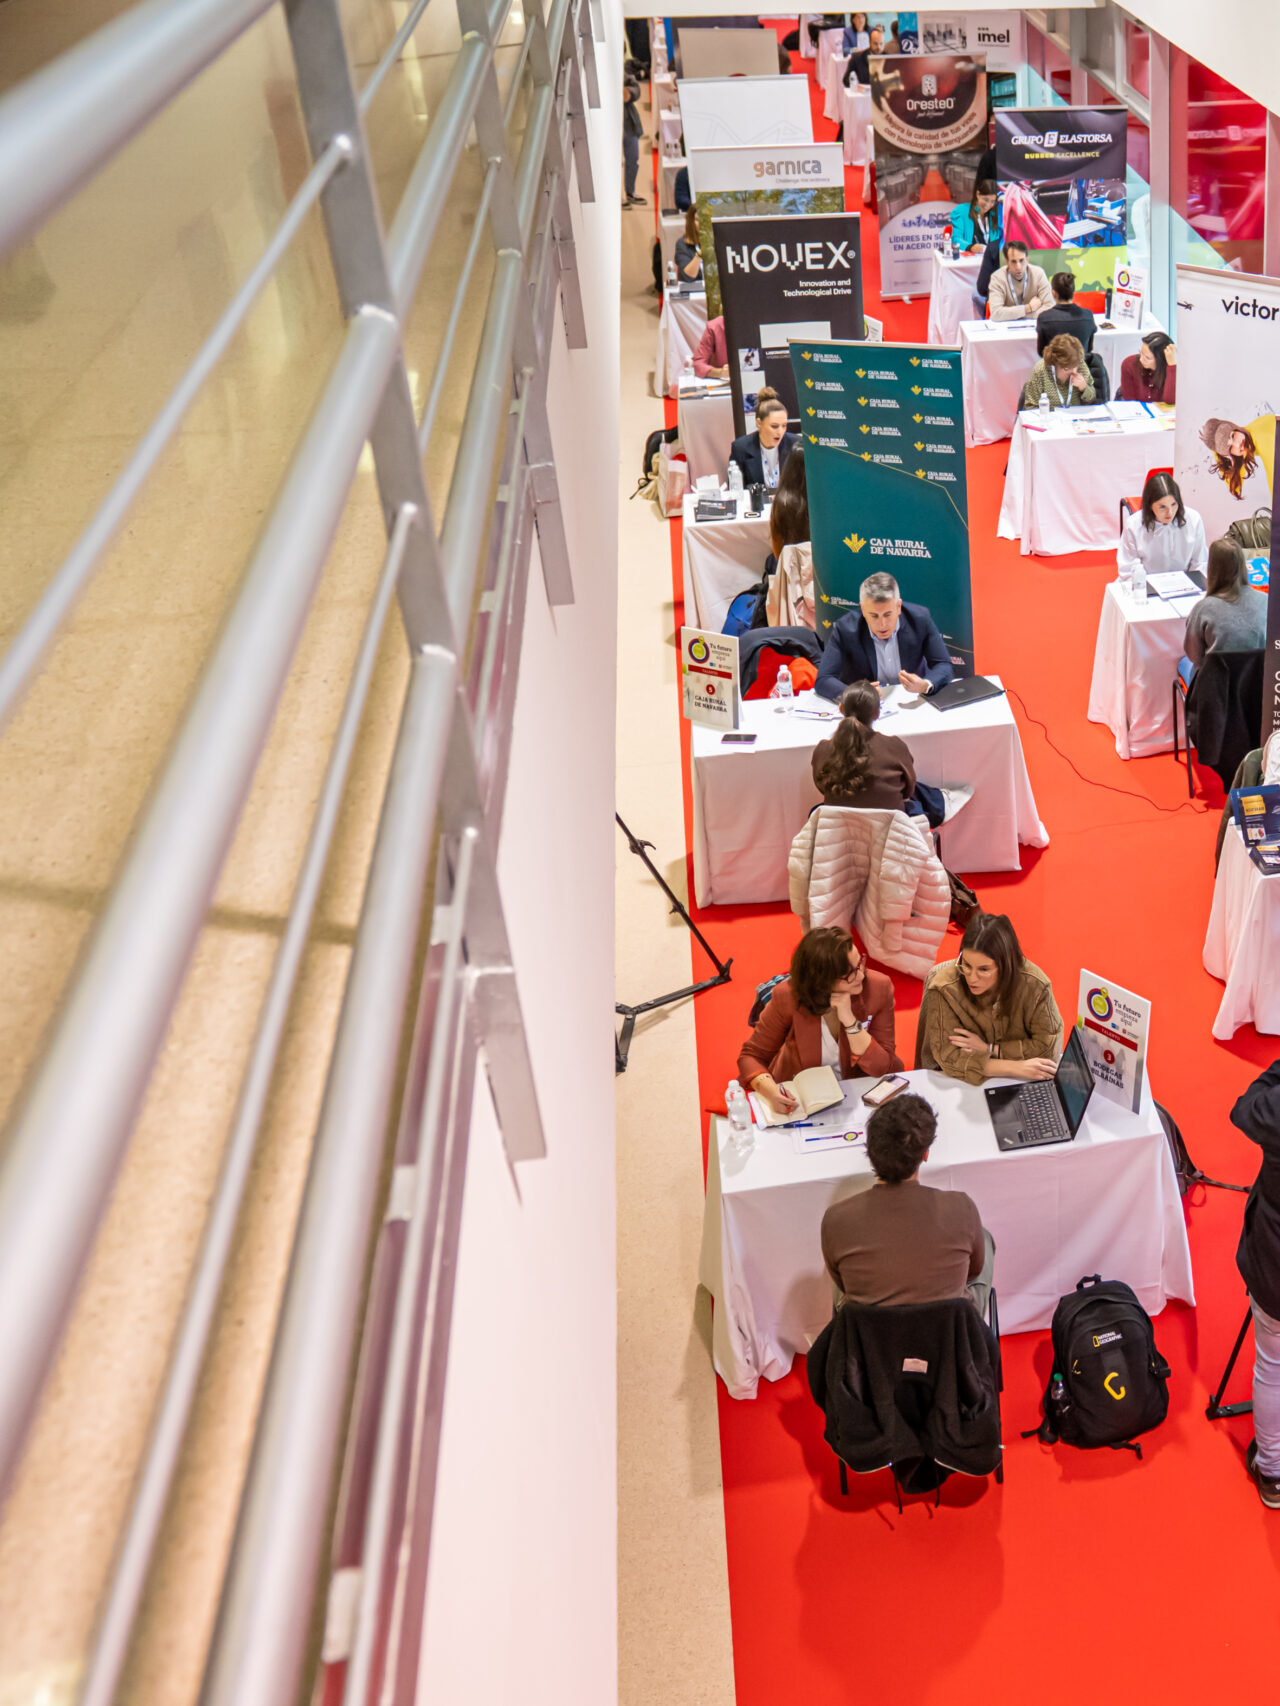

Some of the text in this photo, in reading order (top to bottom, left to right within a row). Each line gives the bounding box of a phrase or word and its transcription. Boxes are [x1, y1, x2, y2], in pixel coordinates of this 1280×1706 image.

[978, 28, 1010, 43] imel
[1011, 135, 1043, 145] GRUPO
[1059, 134, 1112, 143] ELASTORSA
[754, 160, 822, 178] garnica
[906, 242, 931, 250] ACERO
[838, 278, 851, 286] and
[783, 288, 832, 297] Technological
[870, 538, 927, 549] CAJA RURAL
[870, 546, 932, 559] DE NAVARRA
[1114, 1000, 1141, 1018] Tu futuro
[1093, 1060, 1122, 1080] BODEGAS
